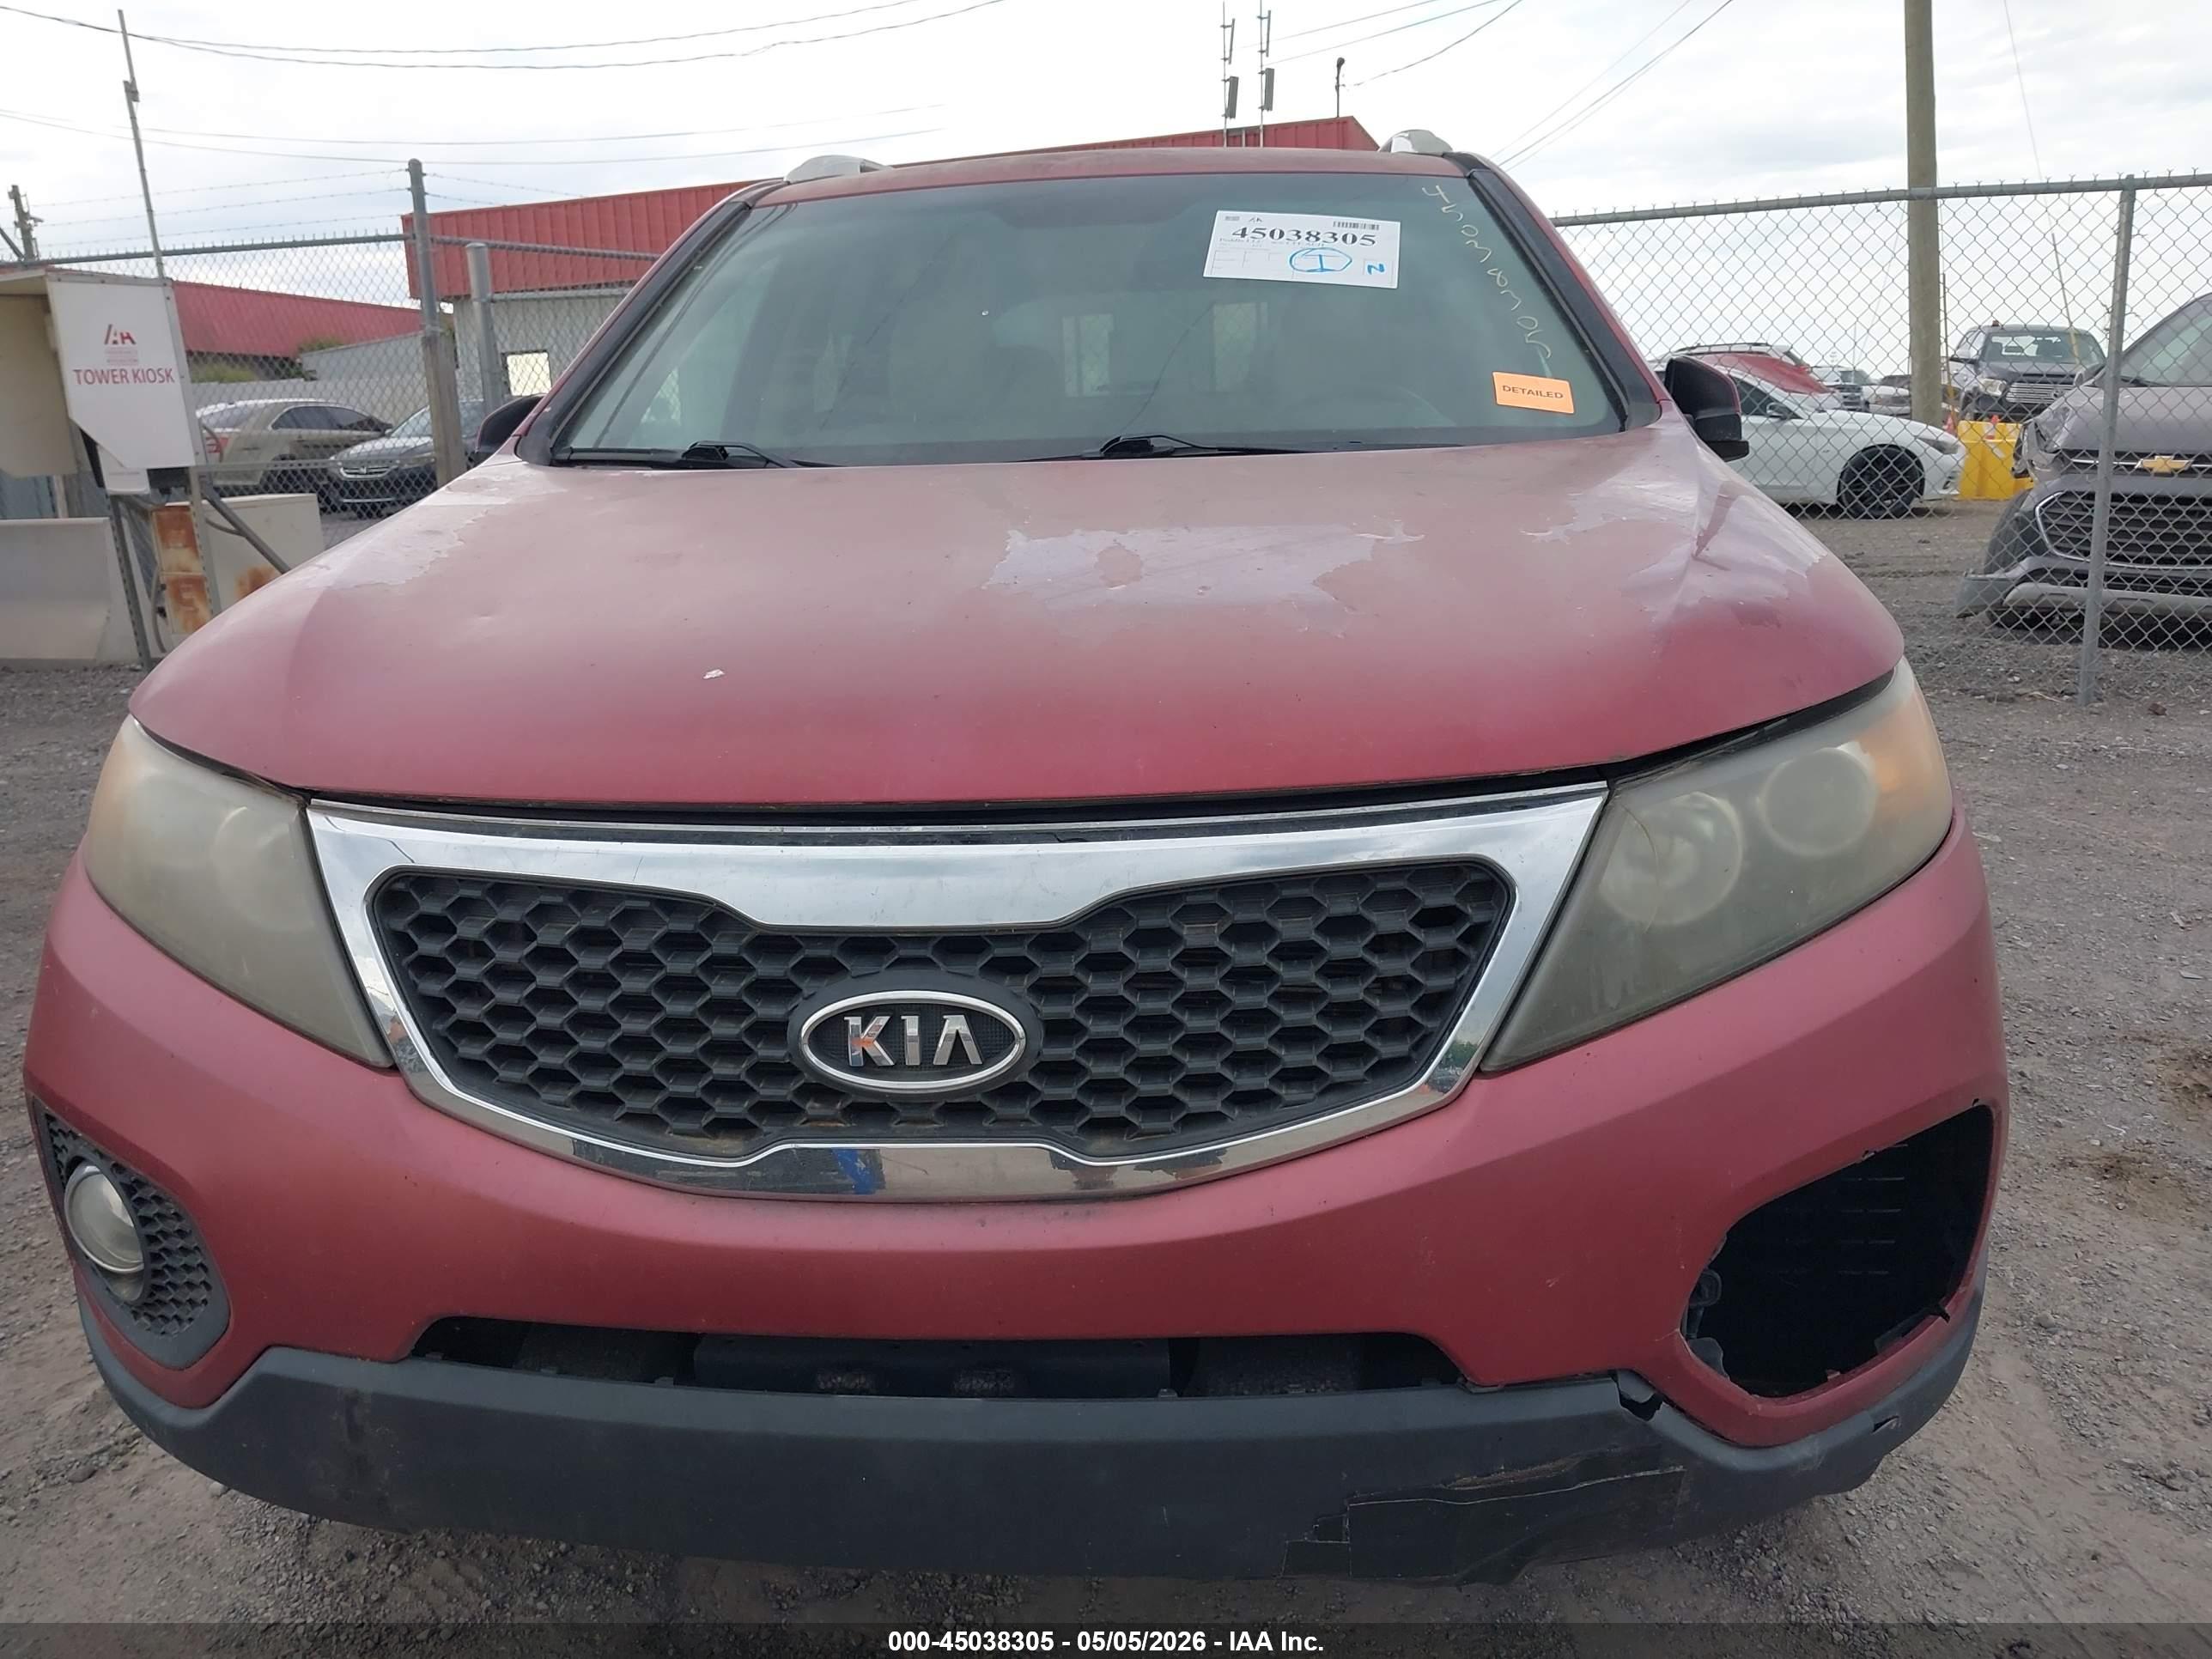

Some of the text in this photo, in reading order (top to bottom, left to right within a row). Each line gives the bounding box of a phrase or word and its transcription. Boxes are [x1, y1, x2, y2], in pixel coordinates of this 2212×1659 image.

[1231, 227, 1376, 246] 45038305
[73, 368, 174, 385] TOWER KIOSK
[1502, 385, 1564, 398] DETAILED
[843, 1015, 983, 1066] KIA
